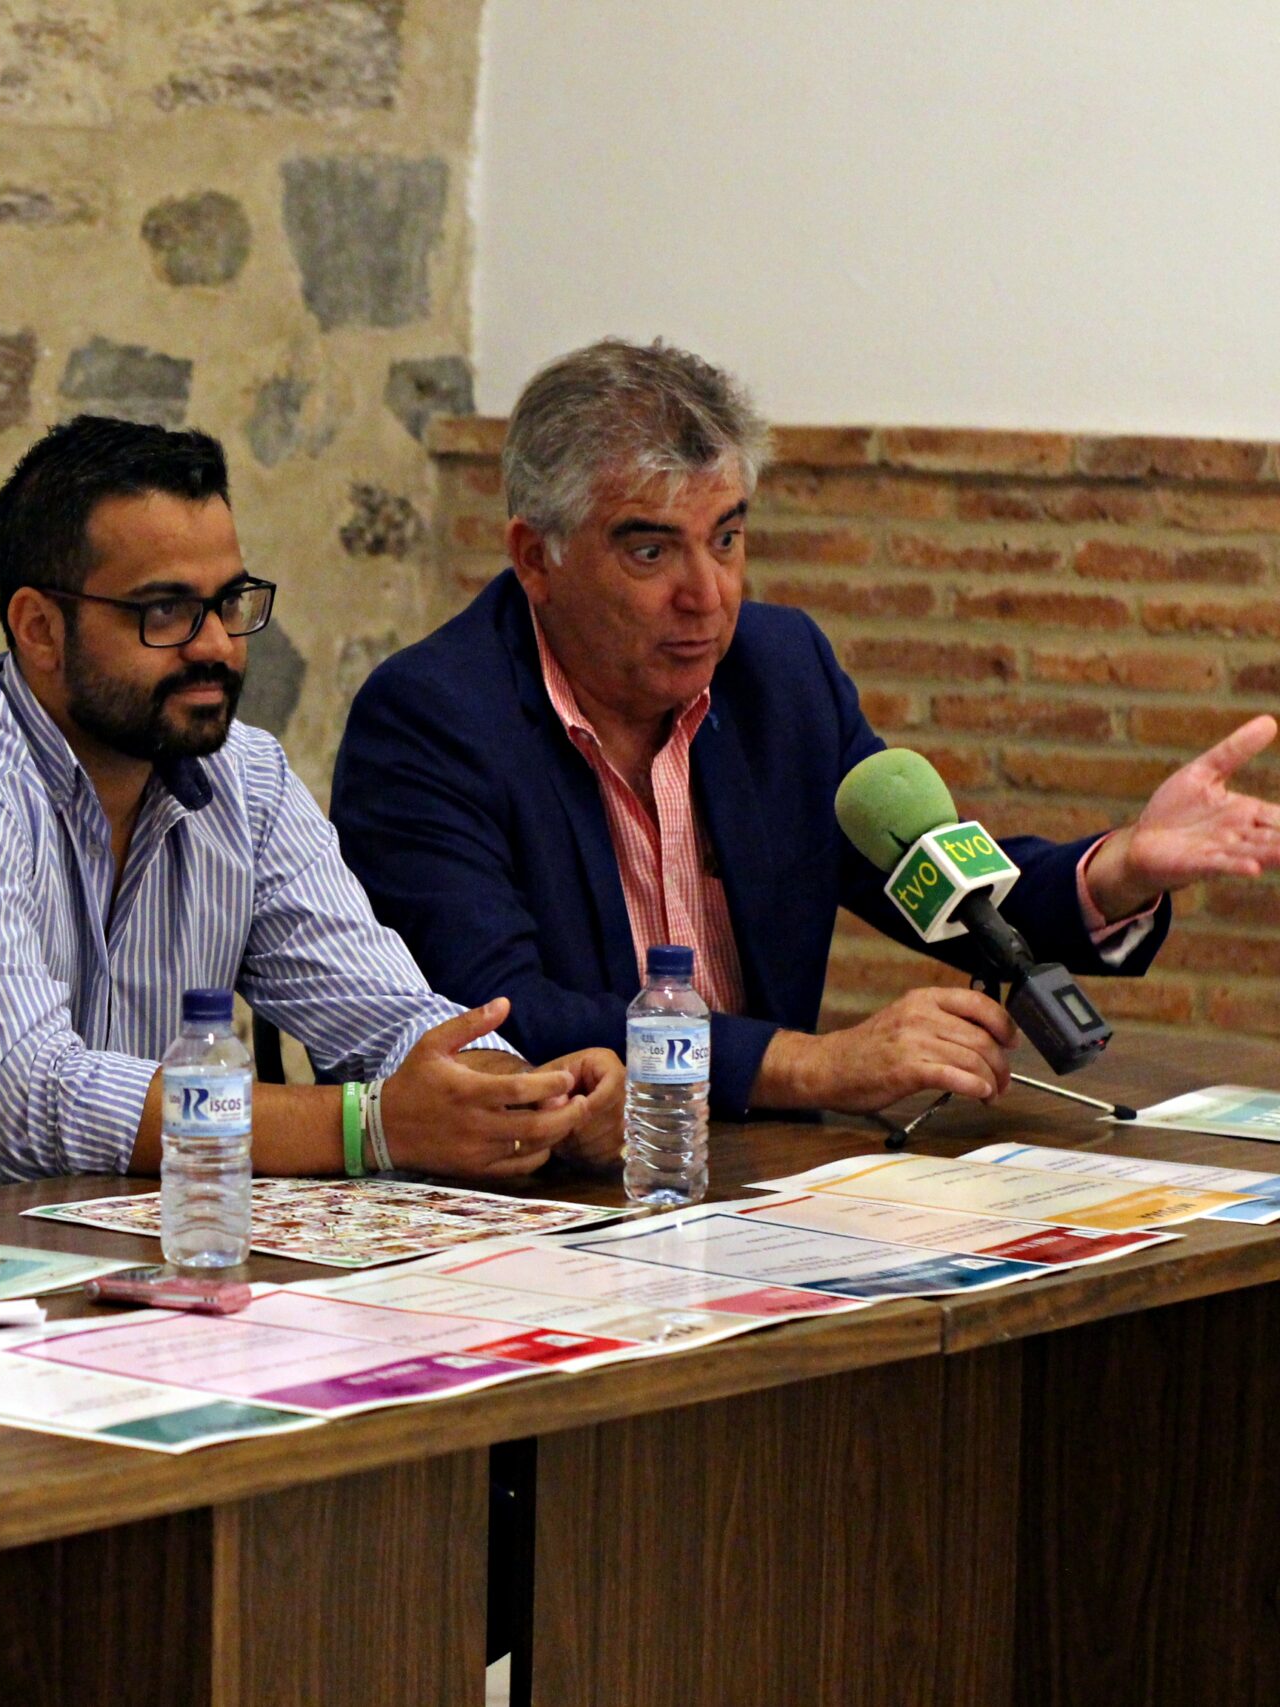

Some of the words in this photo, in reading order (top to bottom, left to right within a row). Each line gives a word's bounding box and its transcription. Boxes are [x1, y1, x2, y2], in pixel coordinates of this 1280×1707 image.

[942, 835, 993, 862] tvo
[897, 861, 938, 911] tvo
[181, 1087, 242, 1121] Riscos
